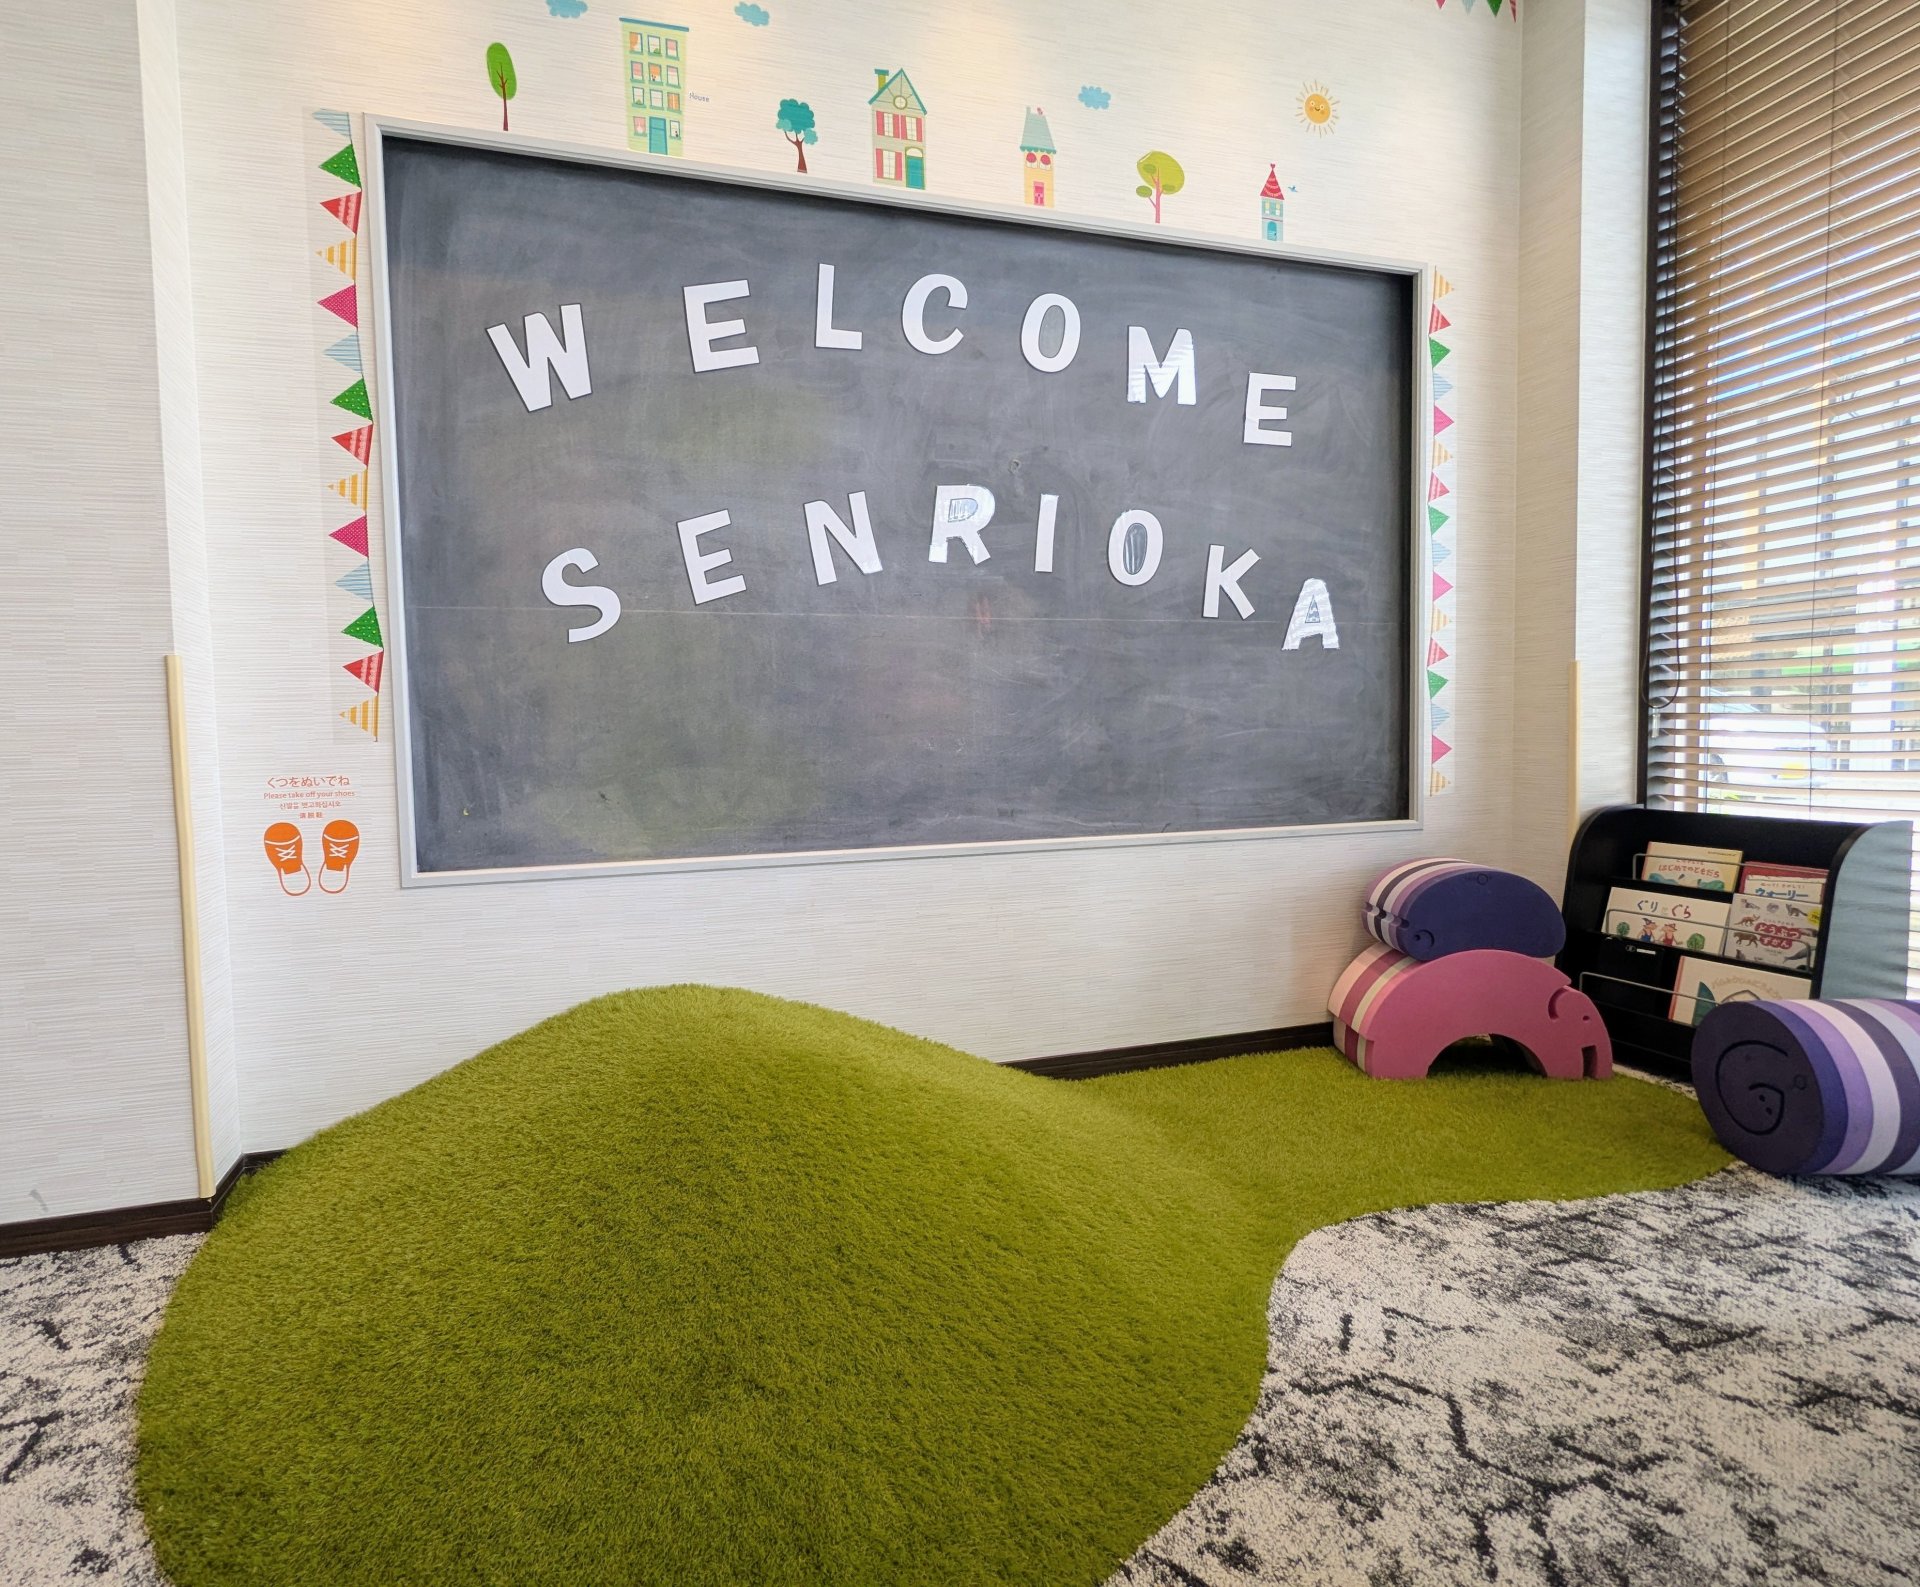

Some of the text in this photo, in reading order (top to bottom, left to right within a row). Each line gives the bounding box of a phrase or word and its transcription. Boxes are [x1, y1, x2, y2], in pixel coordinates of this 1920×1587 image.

[689, 91, 710, 103] House
[487, 263, 1297, 447] WELCOME
[541, 484, 1340, 651] SENRIOKA
[267, 775, 350, 788] くつをぬいでね
[305, 790, 316, 798] off
[316, 790, 333, 799] your
[334, 790, 355, 798] shoes
[1757, 924, 1799, 938] どうぶつ
[1763, 937, 1790, 949] ずかん
